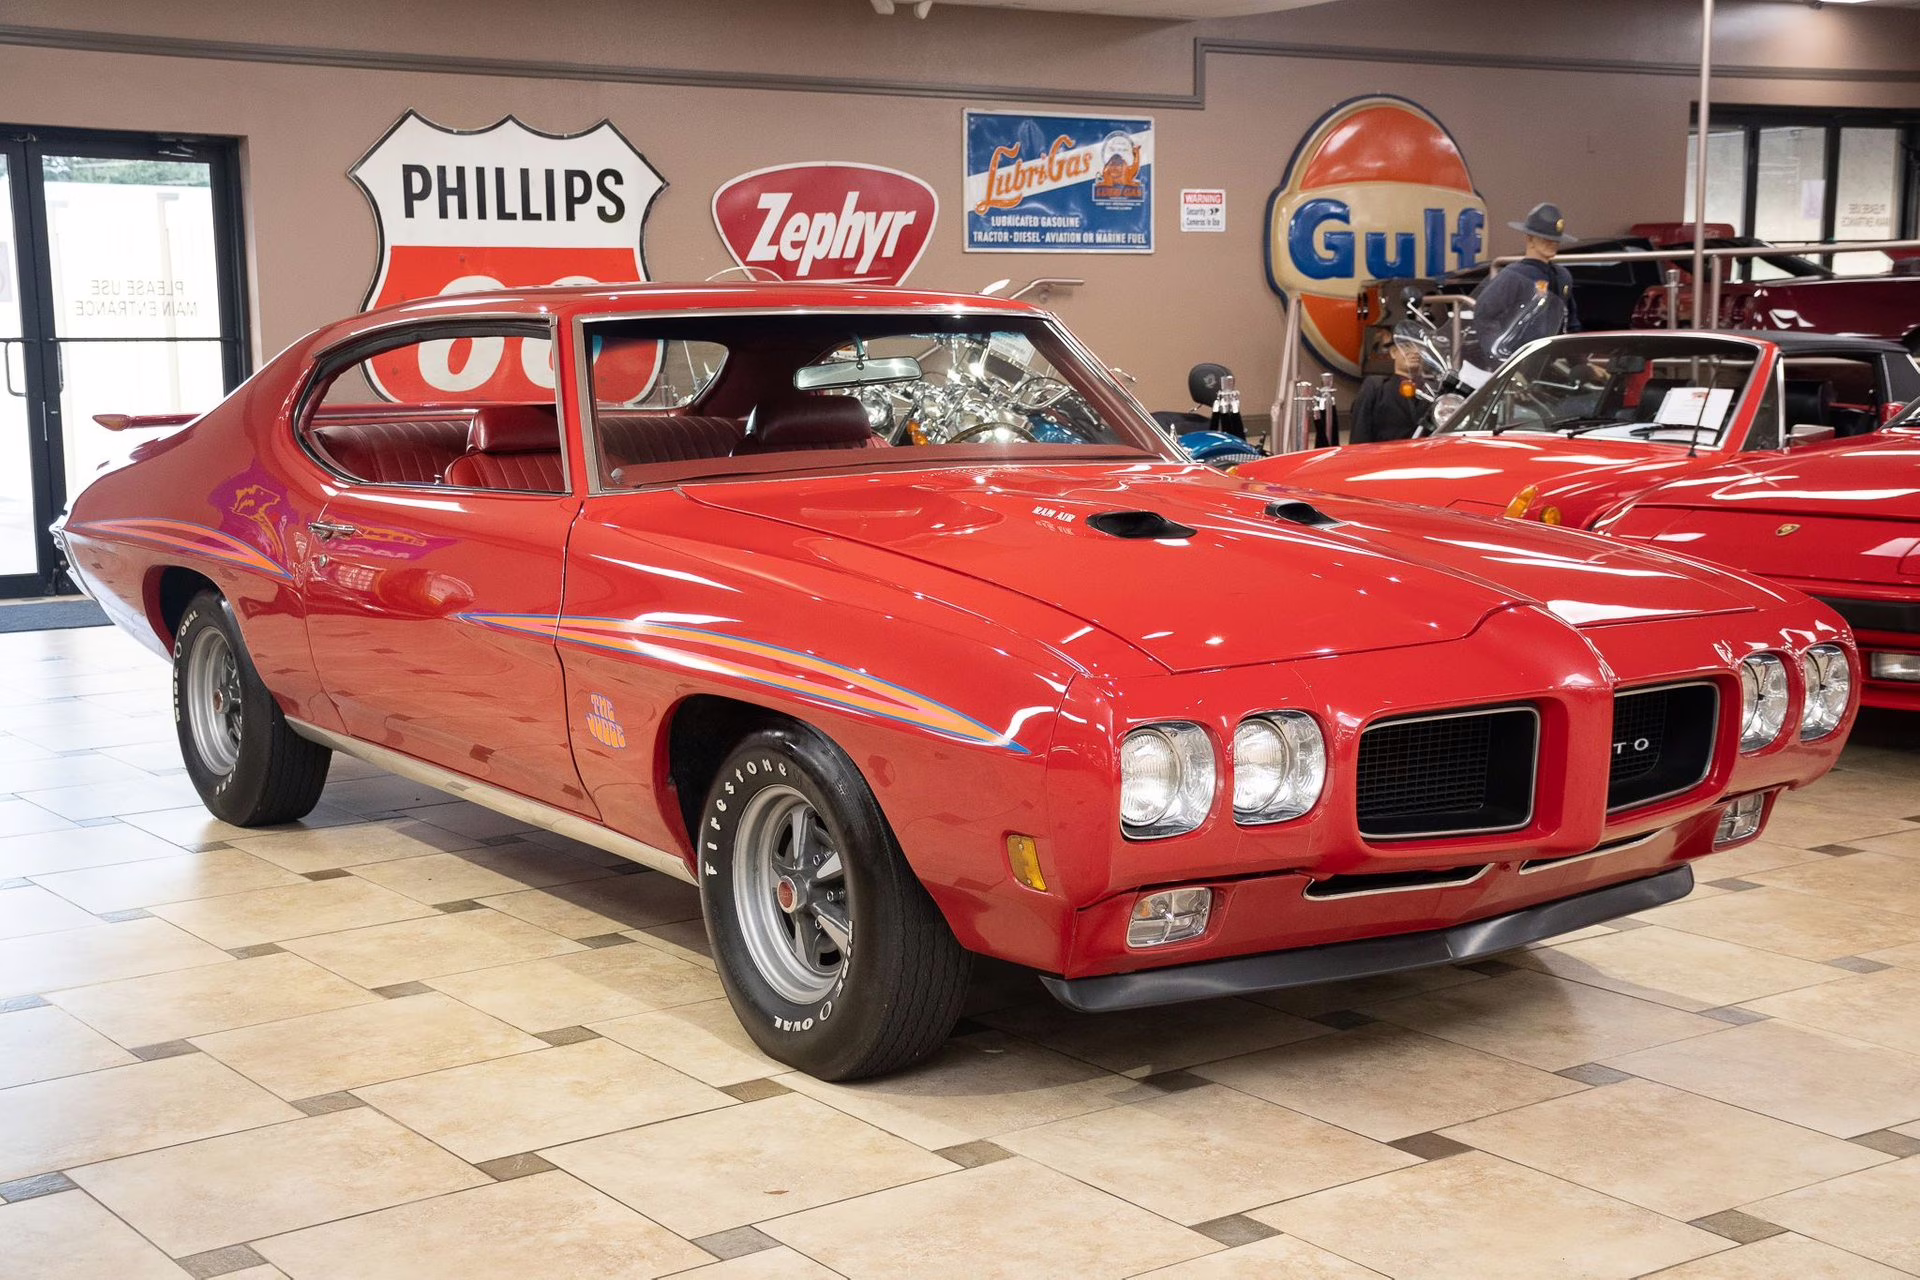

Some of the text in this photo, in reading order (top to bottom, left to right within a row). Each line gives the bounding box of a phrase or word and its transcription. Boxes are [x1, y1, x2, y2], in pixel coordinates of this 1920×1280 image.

[402, 164, 626, 223] PHILLIPS
[1184, 193, 1222, 204] WARNING
[746, 191, 917, 276] Zephyr
[991, 215, 1080, 228] LUBRICATED GASOLINE
[973, 231, 1147, 244] TRACTOR DIESEL AVIATION OR MARINE FUEL
[1288, 198, 1485, 281] Gulf
[1032, 505, 1077, 523] RAM AIR
[590, 691, 615, 721] THE
[585, 712, 626, 748] JUDGE
[1613, 738, 1649, 754] TO
[705, 759, 787, 876] Firestone
[774, 1015, 814, 1032] OVAL
